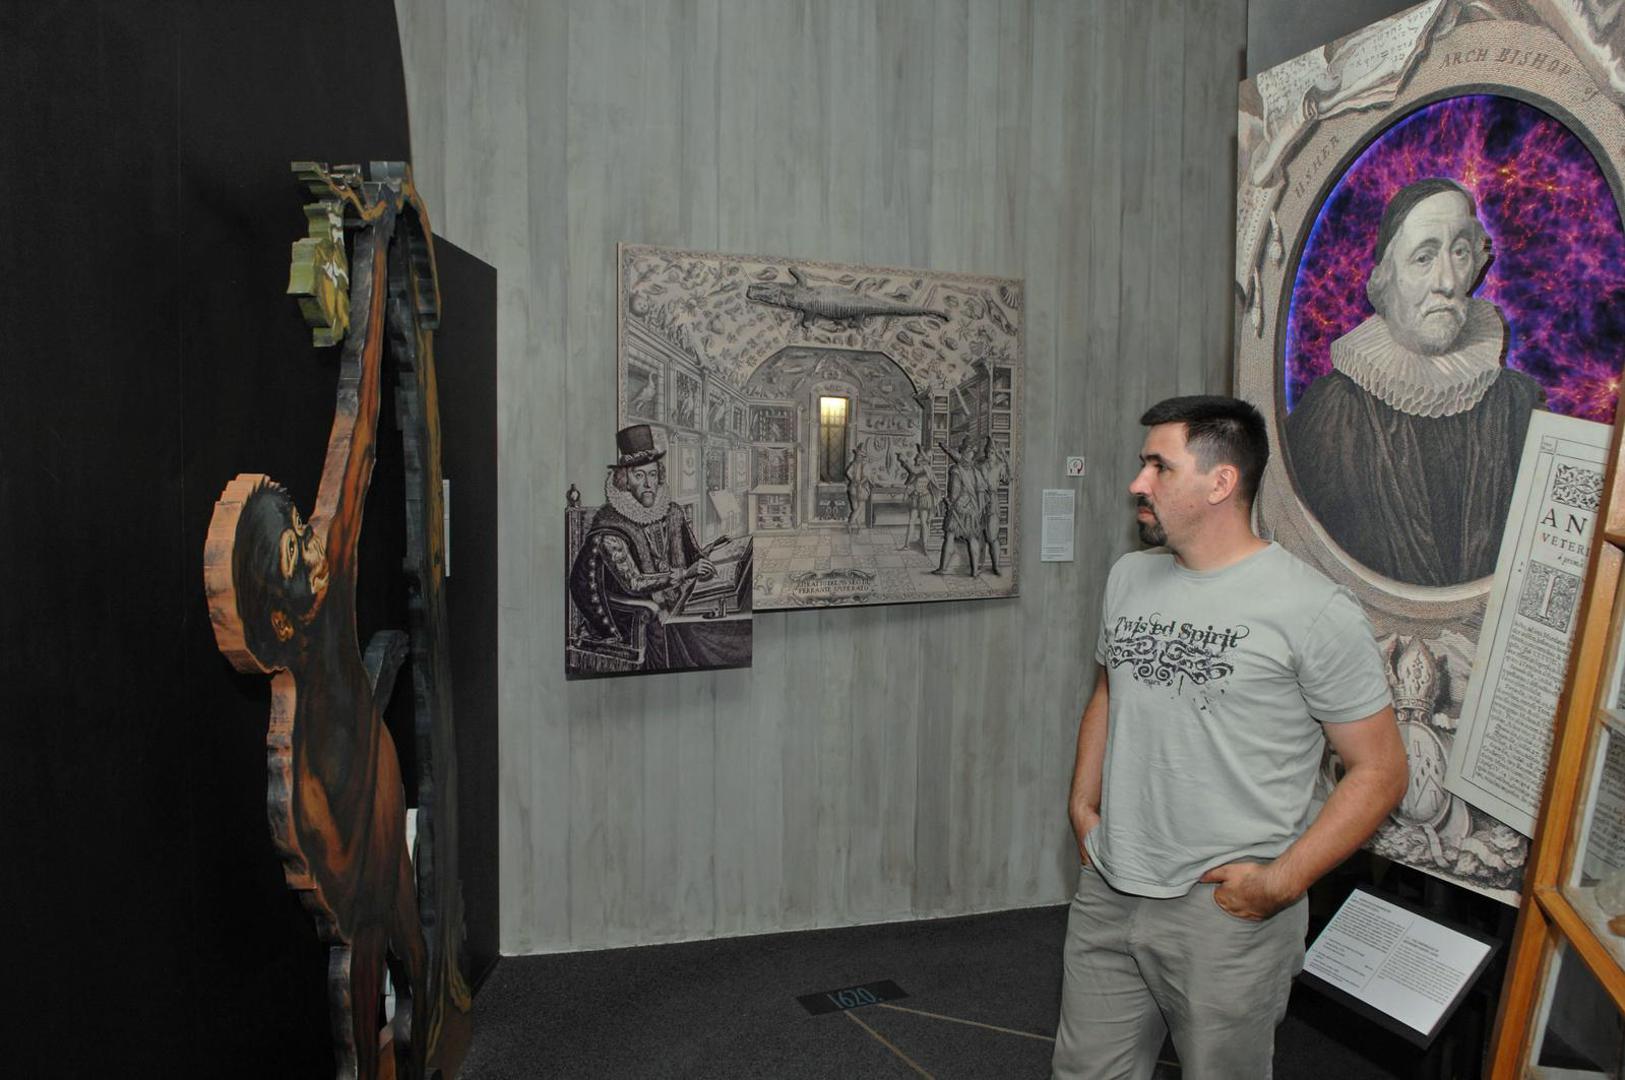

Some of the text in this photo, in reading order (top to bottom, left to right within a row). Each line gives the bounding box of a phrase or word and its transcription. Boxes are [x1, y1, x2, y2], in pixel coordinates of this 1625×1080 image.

[1440, 48, 1489, 69] ARCH
[1495, 48, 1573, 77] BISHOP
[1115, 611, 1251, 652] Twisted Spirit
[826, 986, 877, 1009] 1620
